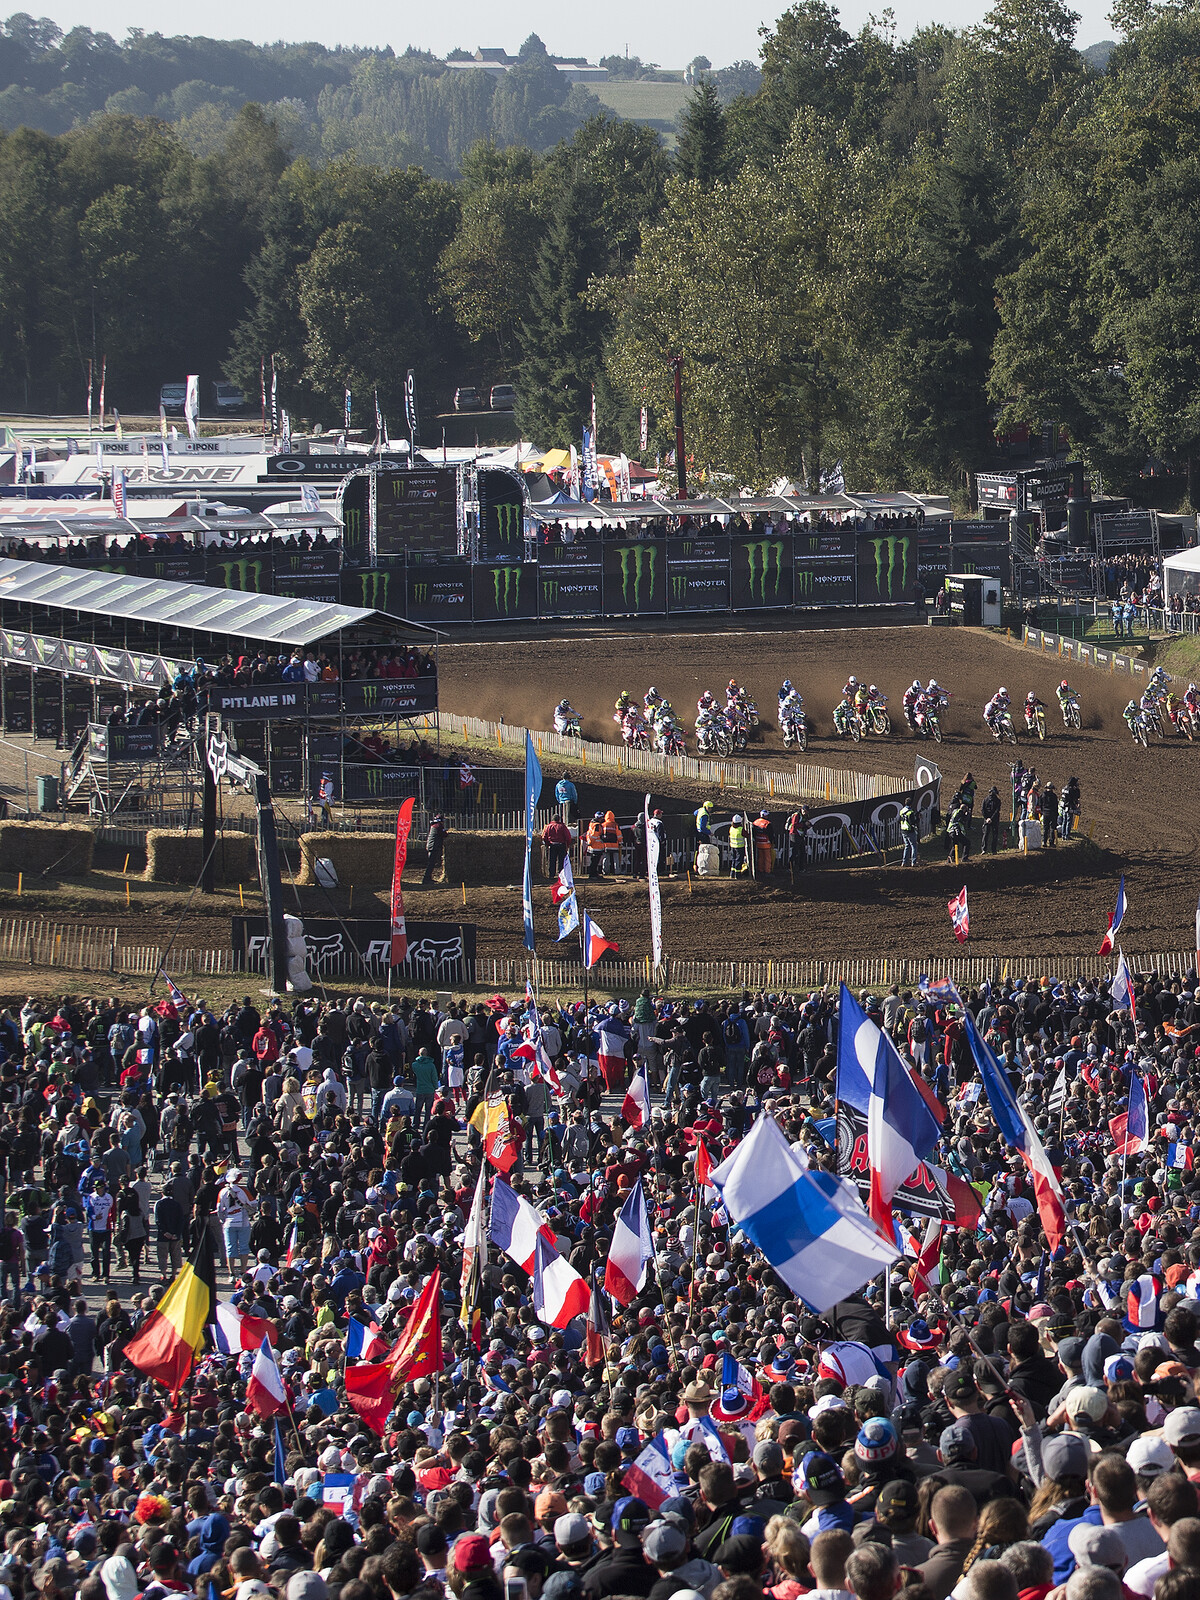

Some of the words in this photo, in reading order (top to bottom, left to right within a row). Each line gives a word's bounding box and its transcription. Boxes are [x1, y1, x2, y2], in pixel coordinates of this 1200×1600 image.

[193, 443, 219, 451] IPONE
[1037, 482, 1065, 496] PADDOCK
[815, 575, 852, 583] MONSTER
[688, 579, 726, 588] MONSTER
[560, 584, 598, 592] MONSTER
[222, 695, 278, 708] PITLANE
[283, 694, 296, 706] IN
